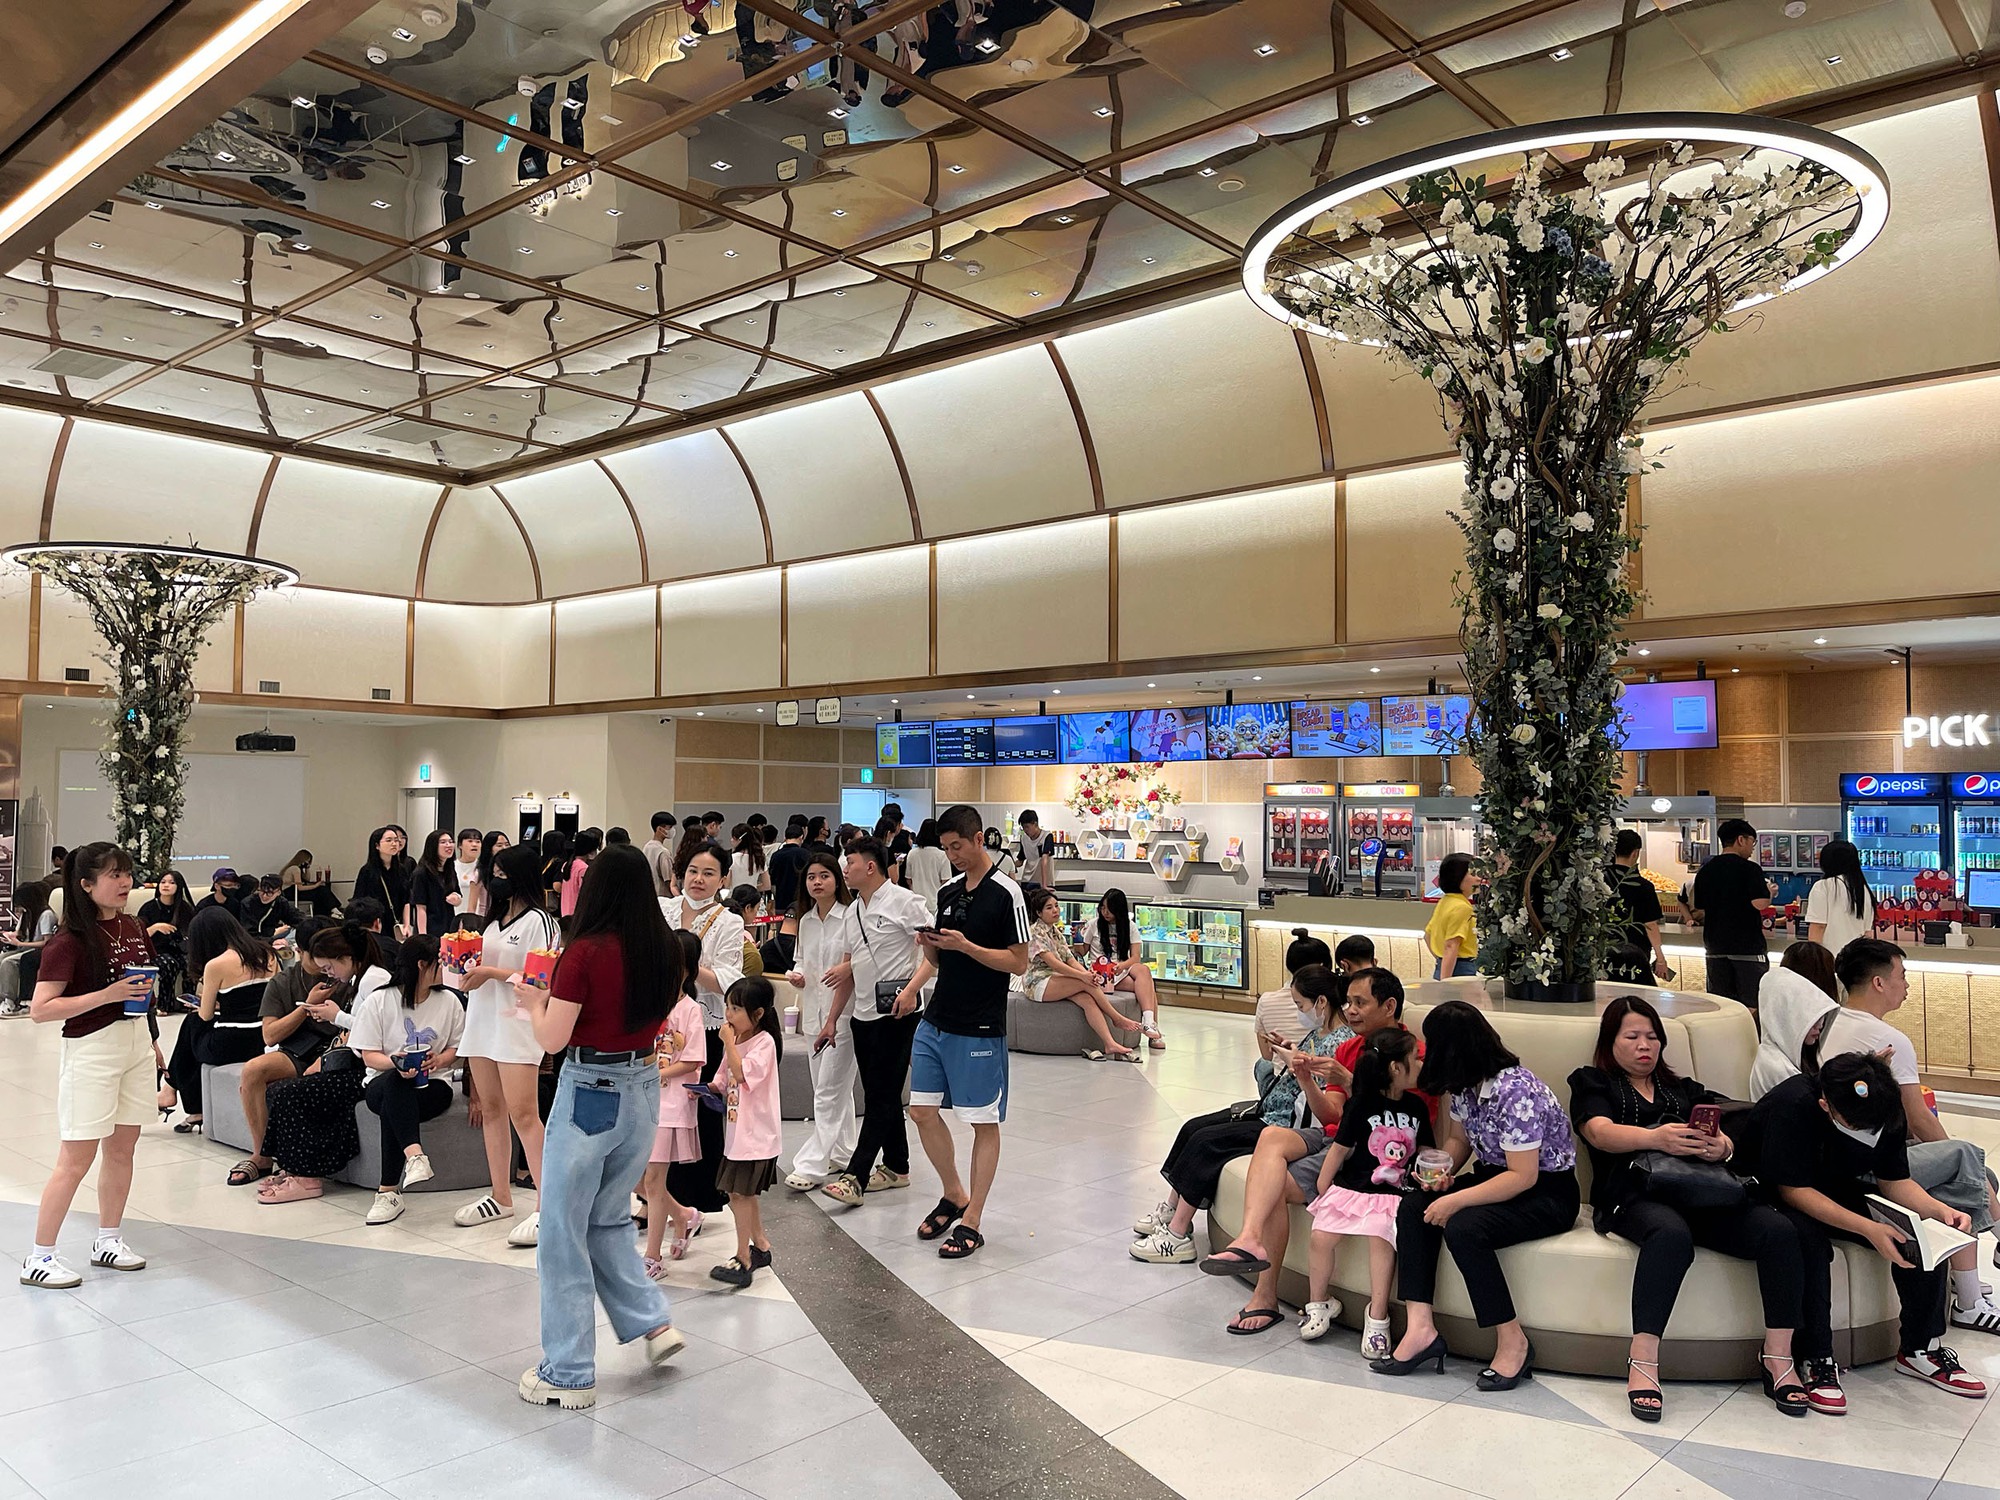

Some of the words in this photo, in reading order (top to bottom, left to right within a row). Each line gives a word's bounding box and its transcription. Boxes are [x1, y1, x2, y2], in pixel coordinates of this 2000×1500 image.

[1903, 713, 1991, 748] PICK
[1301, 786, 1323, 795] CORN
[1380, 786, 1405, 795] CORN
[1880, 778, 1926, 793] pepsi
[1367, 1110, 1420, 1137] BABY
